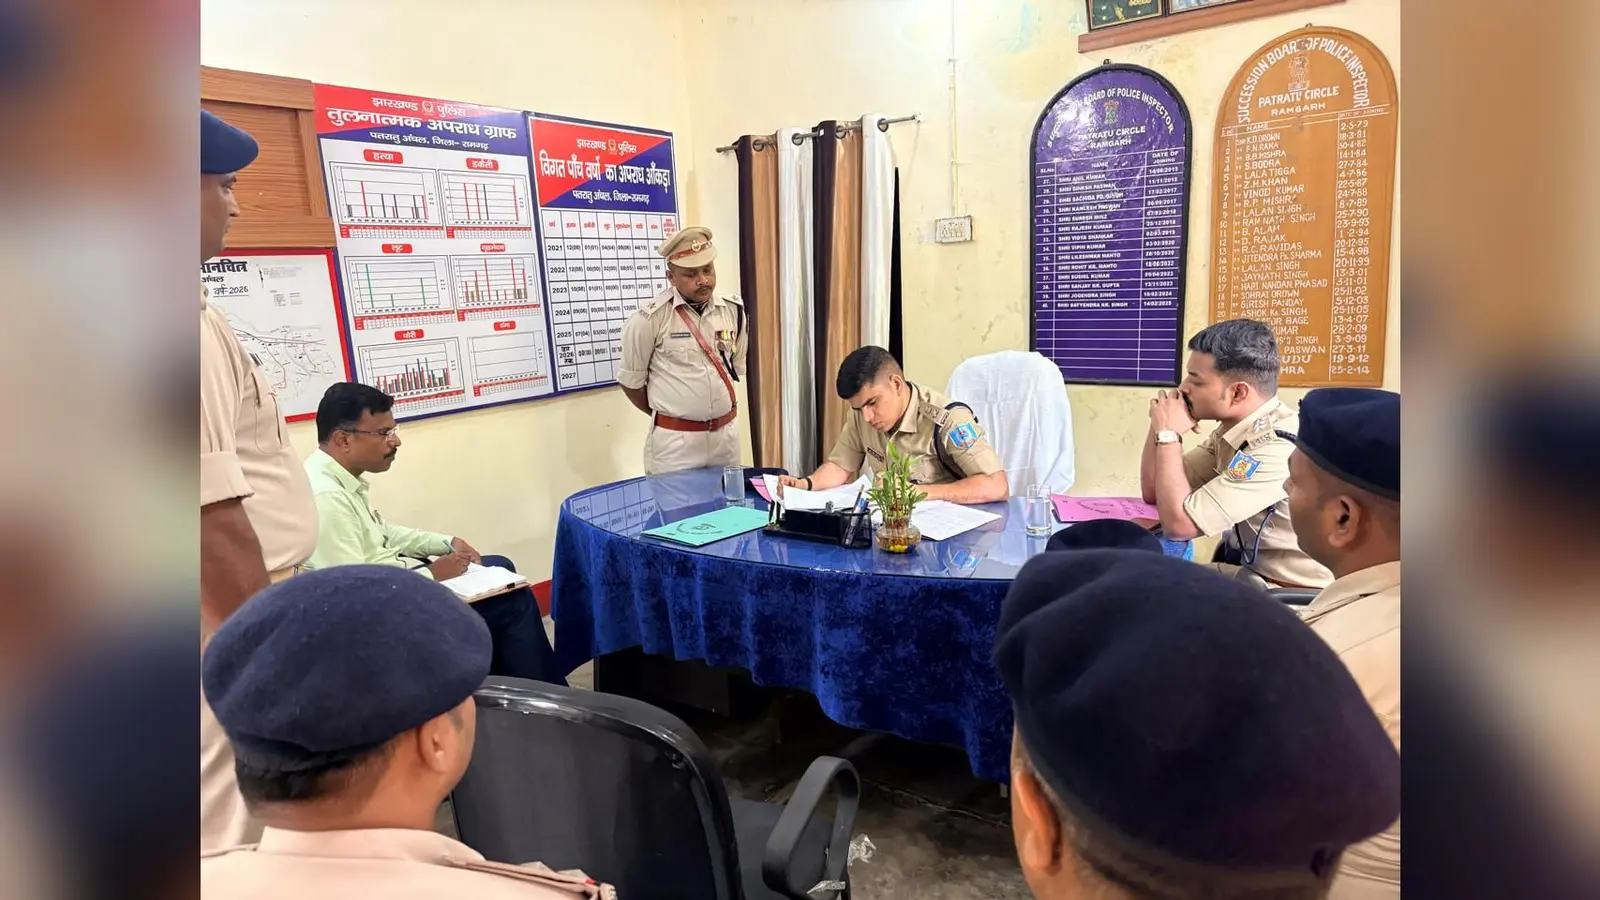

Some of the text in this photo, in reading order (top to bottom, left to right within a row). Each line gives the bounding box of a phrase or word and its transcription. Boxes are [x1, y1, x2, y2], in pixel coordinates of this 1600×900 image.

[1238, 60, 1270, 124] SUCCESSION
[1318, 38, 1352, 62] POLICE
[1346, 55, 1370, 108] INSPECTOR
[1304, 86, 1340, 100] CIRCLE
[371, 97, 466, 117] झारखण्ड पुलिस
[1107, 88, 1116, 97] OF
[1117, 88, 1141, 100] POLICE
[1142, 92, 1175, 134] INSPECTOR
[1271, 102, 1326, 116] RAMGARH
[325, 107, 516, 139] तुलनात्मक अपराध ग्राफ
[1116, 126, 1146, 136] CIRCLE
[369, 132, 400, 144] पतरातु
[1091, 138, 1132, 148] RAMGARH
[372, 152, 394, 161] हत्या
[539, 150, 566, 178] विगत
[605, 164, 618, 182] का
[619, 165, 644, 184] अपराध
[1243, 188, 1270, 199] VINOD
[1276, 184, 1304, 194] KUMAR
[1243, 207, 1274, 218] LALAN
[1254, 234, 1286, 244] RAJAK
[1260, 242, 1302, 252] RAVIDAS
[1242, 254, 1280, 264] JITENDRA
[1290, 250, 1322, 260] SHARMA
[1276, 260, 1300, 270] SINGH
[1284, 270, 1308, 280] SINGH
[1294, 278, 1328, 288] PRASAD
[1240, 308, 1266, 318] ASHOK
[1281, 308, 1308, 316] SINGH
[1286, 316, 1309, 324] BAGE
[1296, 336, 1318, 344] SINGH
[1284, 346, 1326, 354] PASWAN
